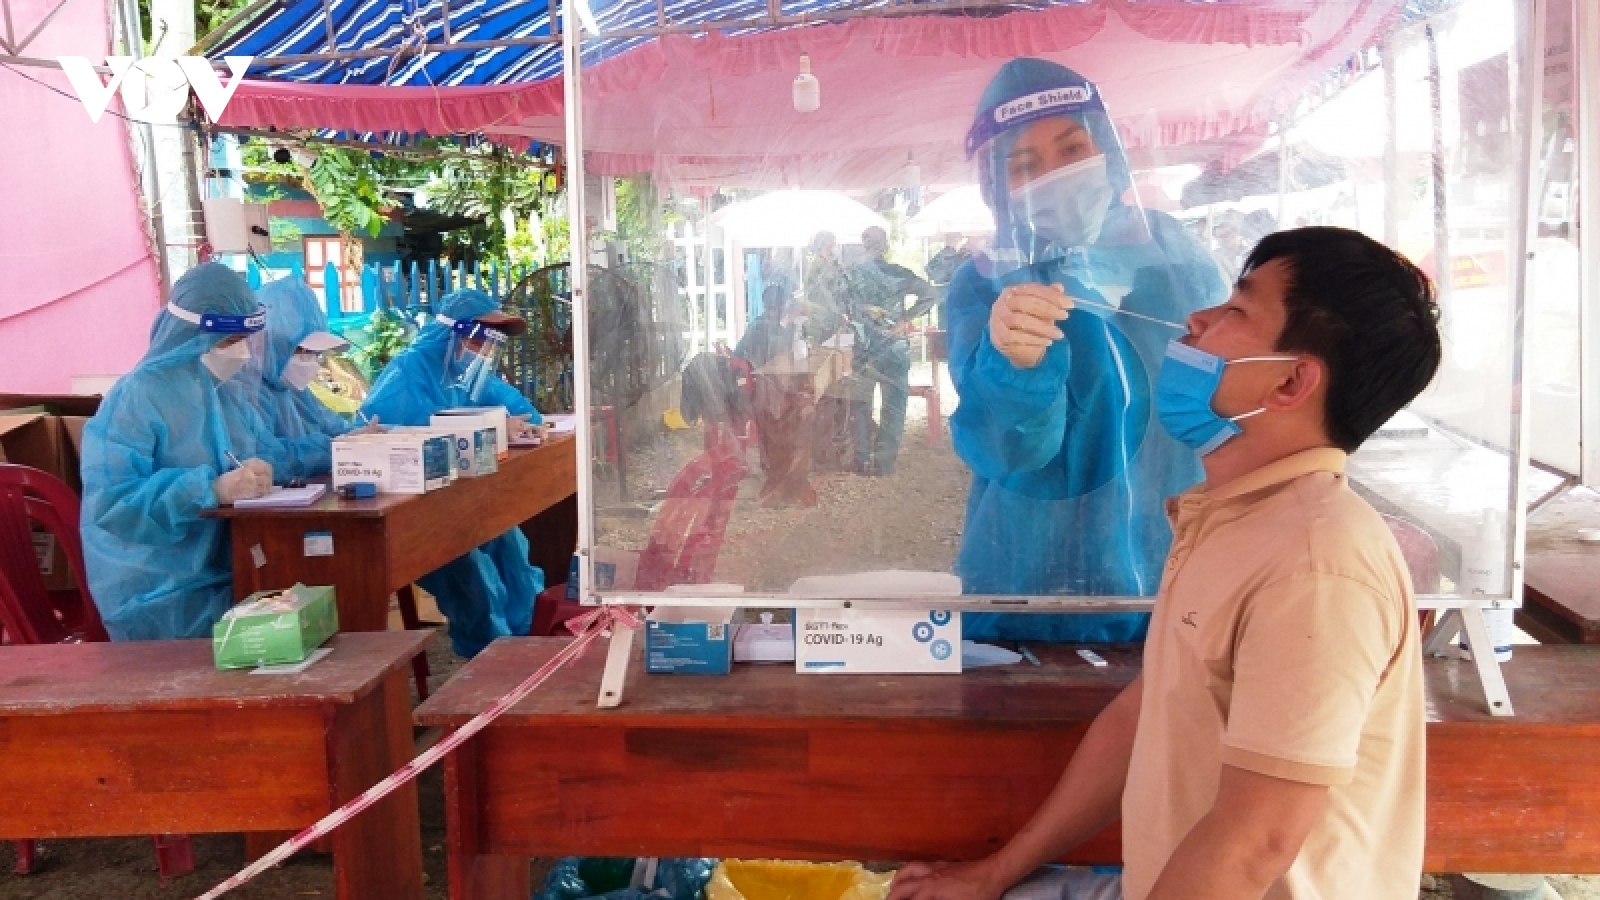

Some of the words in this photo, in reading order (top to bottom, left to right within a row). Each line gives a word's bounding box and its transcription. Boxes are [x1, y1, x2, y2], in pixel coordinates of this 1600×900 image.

[1001, 100, 1033, 119] Face
[1037, 88, 1083, 107] Shield
[804, 633, 864, 646] COVID-19
[865, 633, 883, 648] Ag
